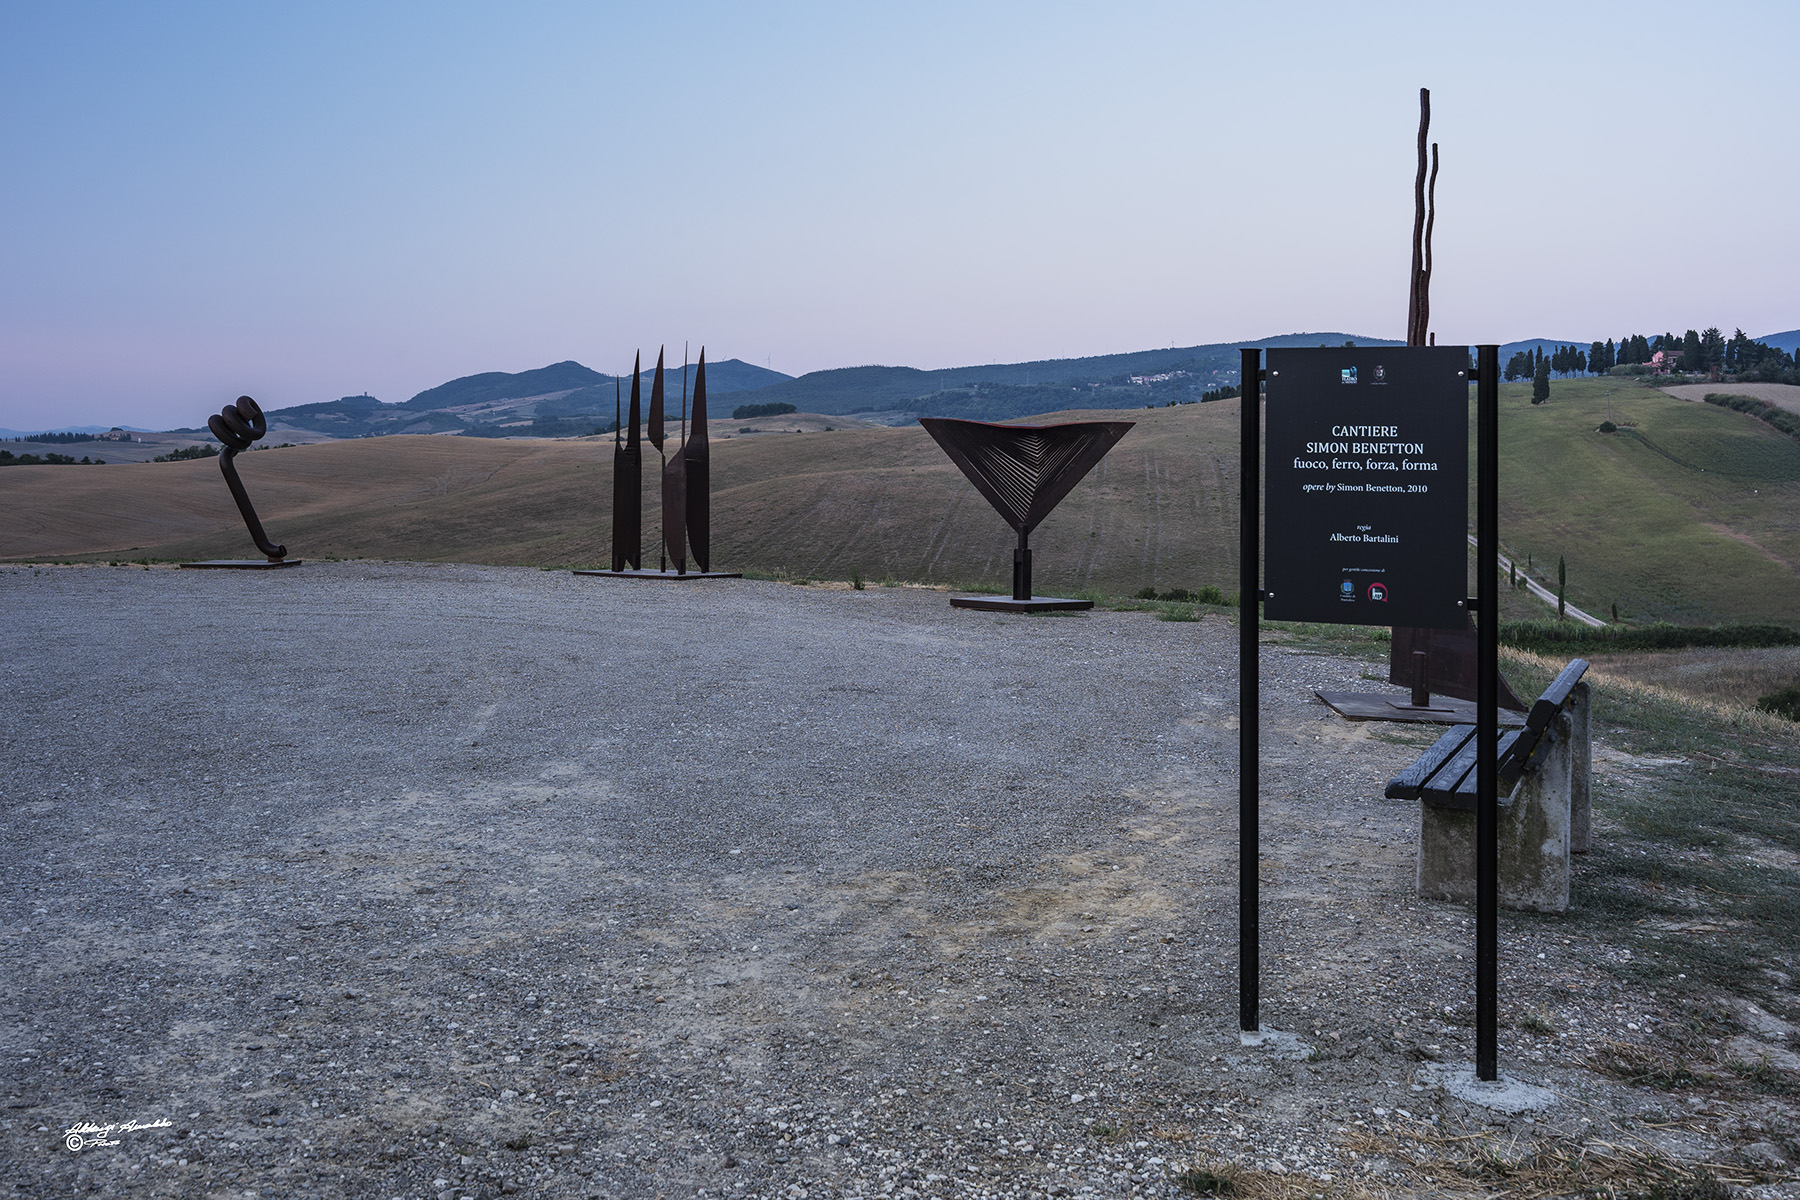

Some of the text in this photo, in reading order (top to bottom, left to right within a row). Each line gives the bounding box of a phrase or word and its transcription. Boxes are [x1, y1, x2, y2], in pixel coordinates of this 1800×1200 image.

[1332, 425, 1398, 437] CANTIERE
[1306, 442, 1424, 455] SIMON BENETTON
[1293, 456, 1438, 471] fuoco, ferro, forza, forma
[1302, 482, 1428, 494] opere by Simon Benetton, 2010
[1356, 524, 1372, 532] regia
[1329, 532, 1399, 544] Alberto Bartalini
